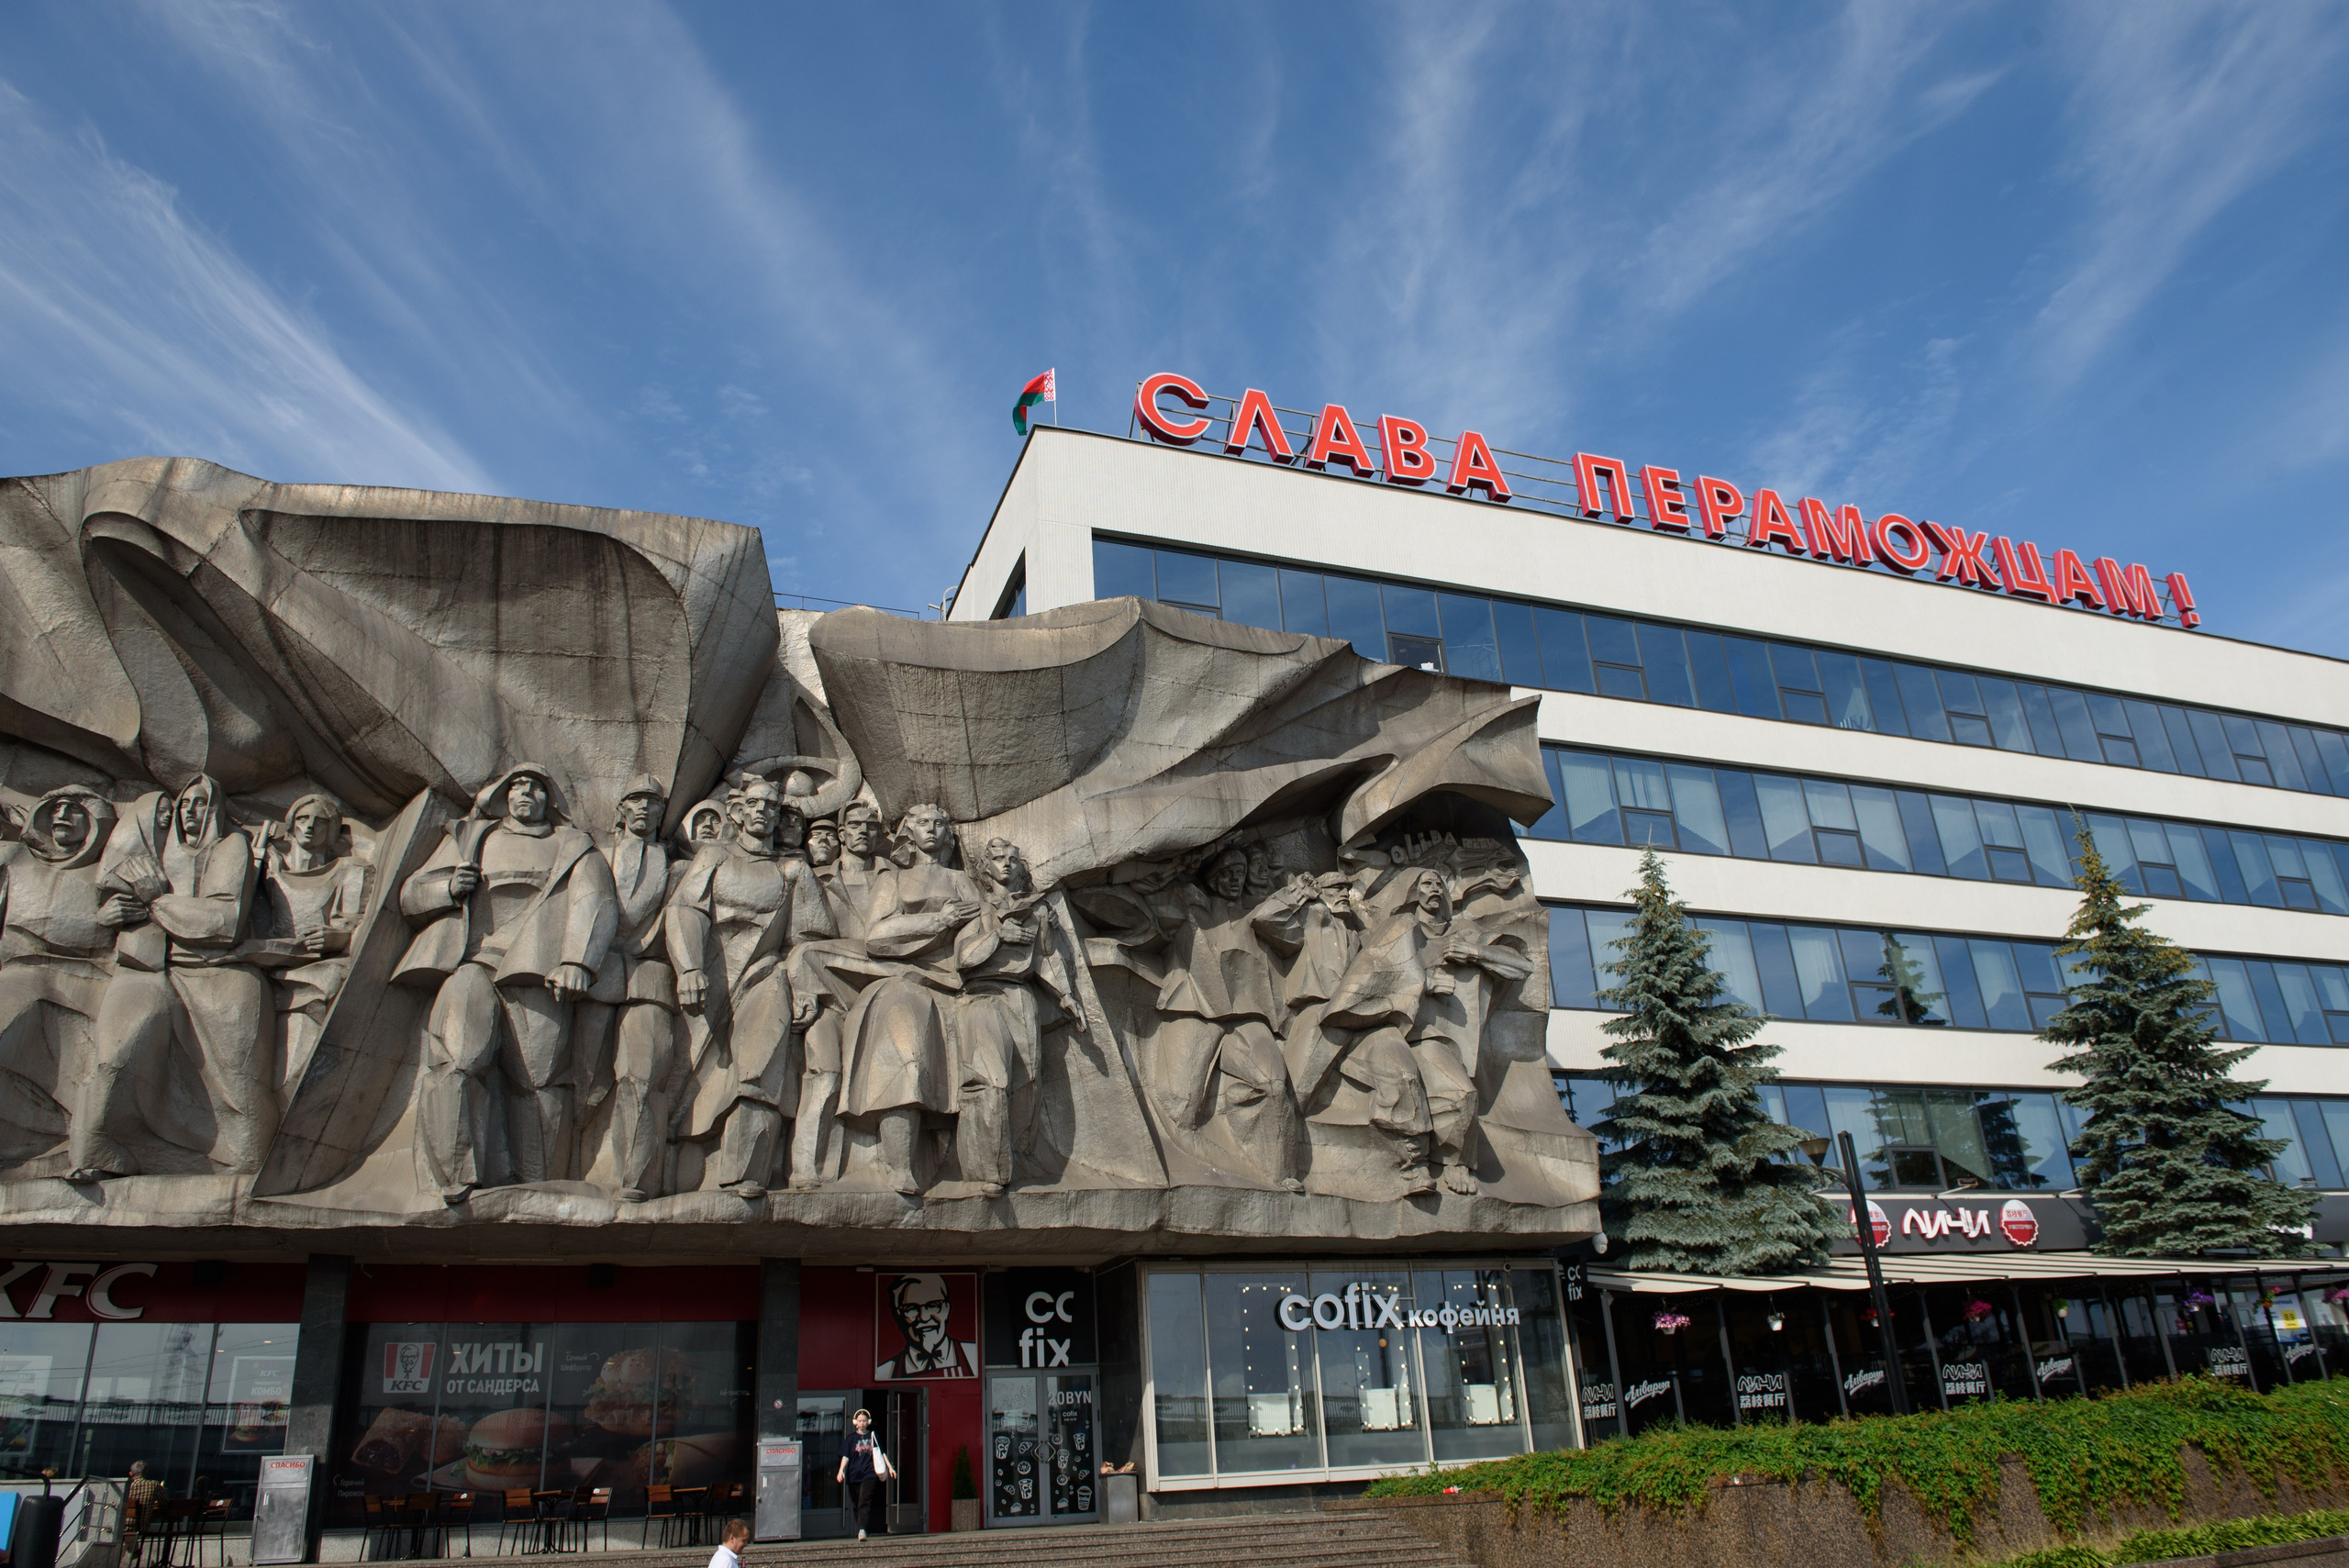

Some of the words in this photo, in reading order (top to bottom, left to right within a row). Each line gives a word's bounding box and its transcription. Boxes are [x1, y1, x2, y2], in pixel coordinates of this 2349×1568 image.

[1135, 372, 1513, 503] СЛАВА
[1572, 451, 2201, 629] ПЕРАМОЖЦАМ!
[1901, 1207, 1991, 1239] ЛИЧИ
[1278, 1282, 1405, 1331] cofix
[1408, 1300, 1520, 1334] кофейня
[1019, 1328, 1071, 1368] fix
[449, 1342, 544, 1374] ХИТЫ
[250, 1386, 282, 1396] КОМБО
[390, 1380, 423, 1391] KFC
[446, 1379, 465, 1394] ОТ
[467, 1378, 540, 1396] САНДЕРСА
[1739, 1393, 1787, 1409] 荔枝餐厅
[765, 1447, 796, 1455] СПАСИБО
[270, 1461, 306, 1469] СПАСИБО
[340, 1477, 365, 1488] Горячий
[338, 1489, 365, 1497] Пирожок
